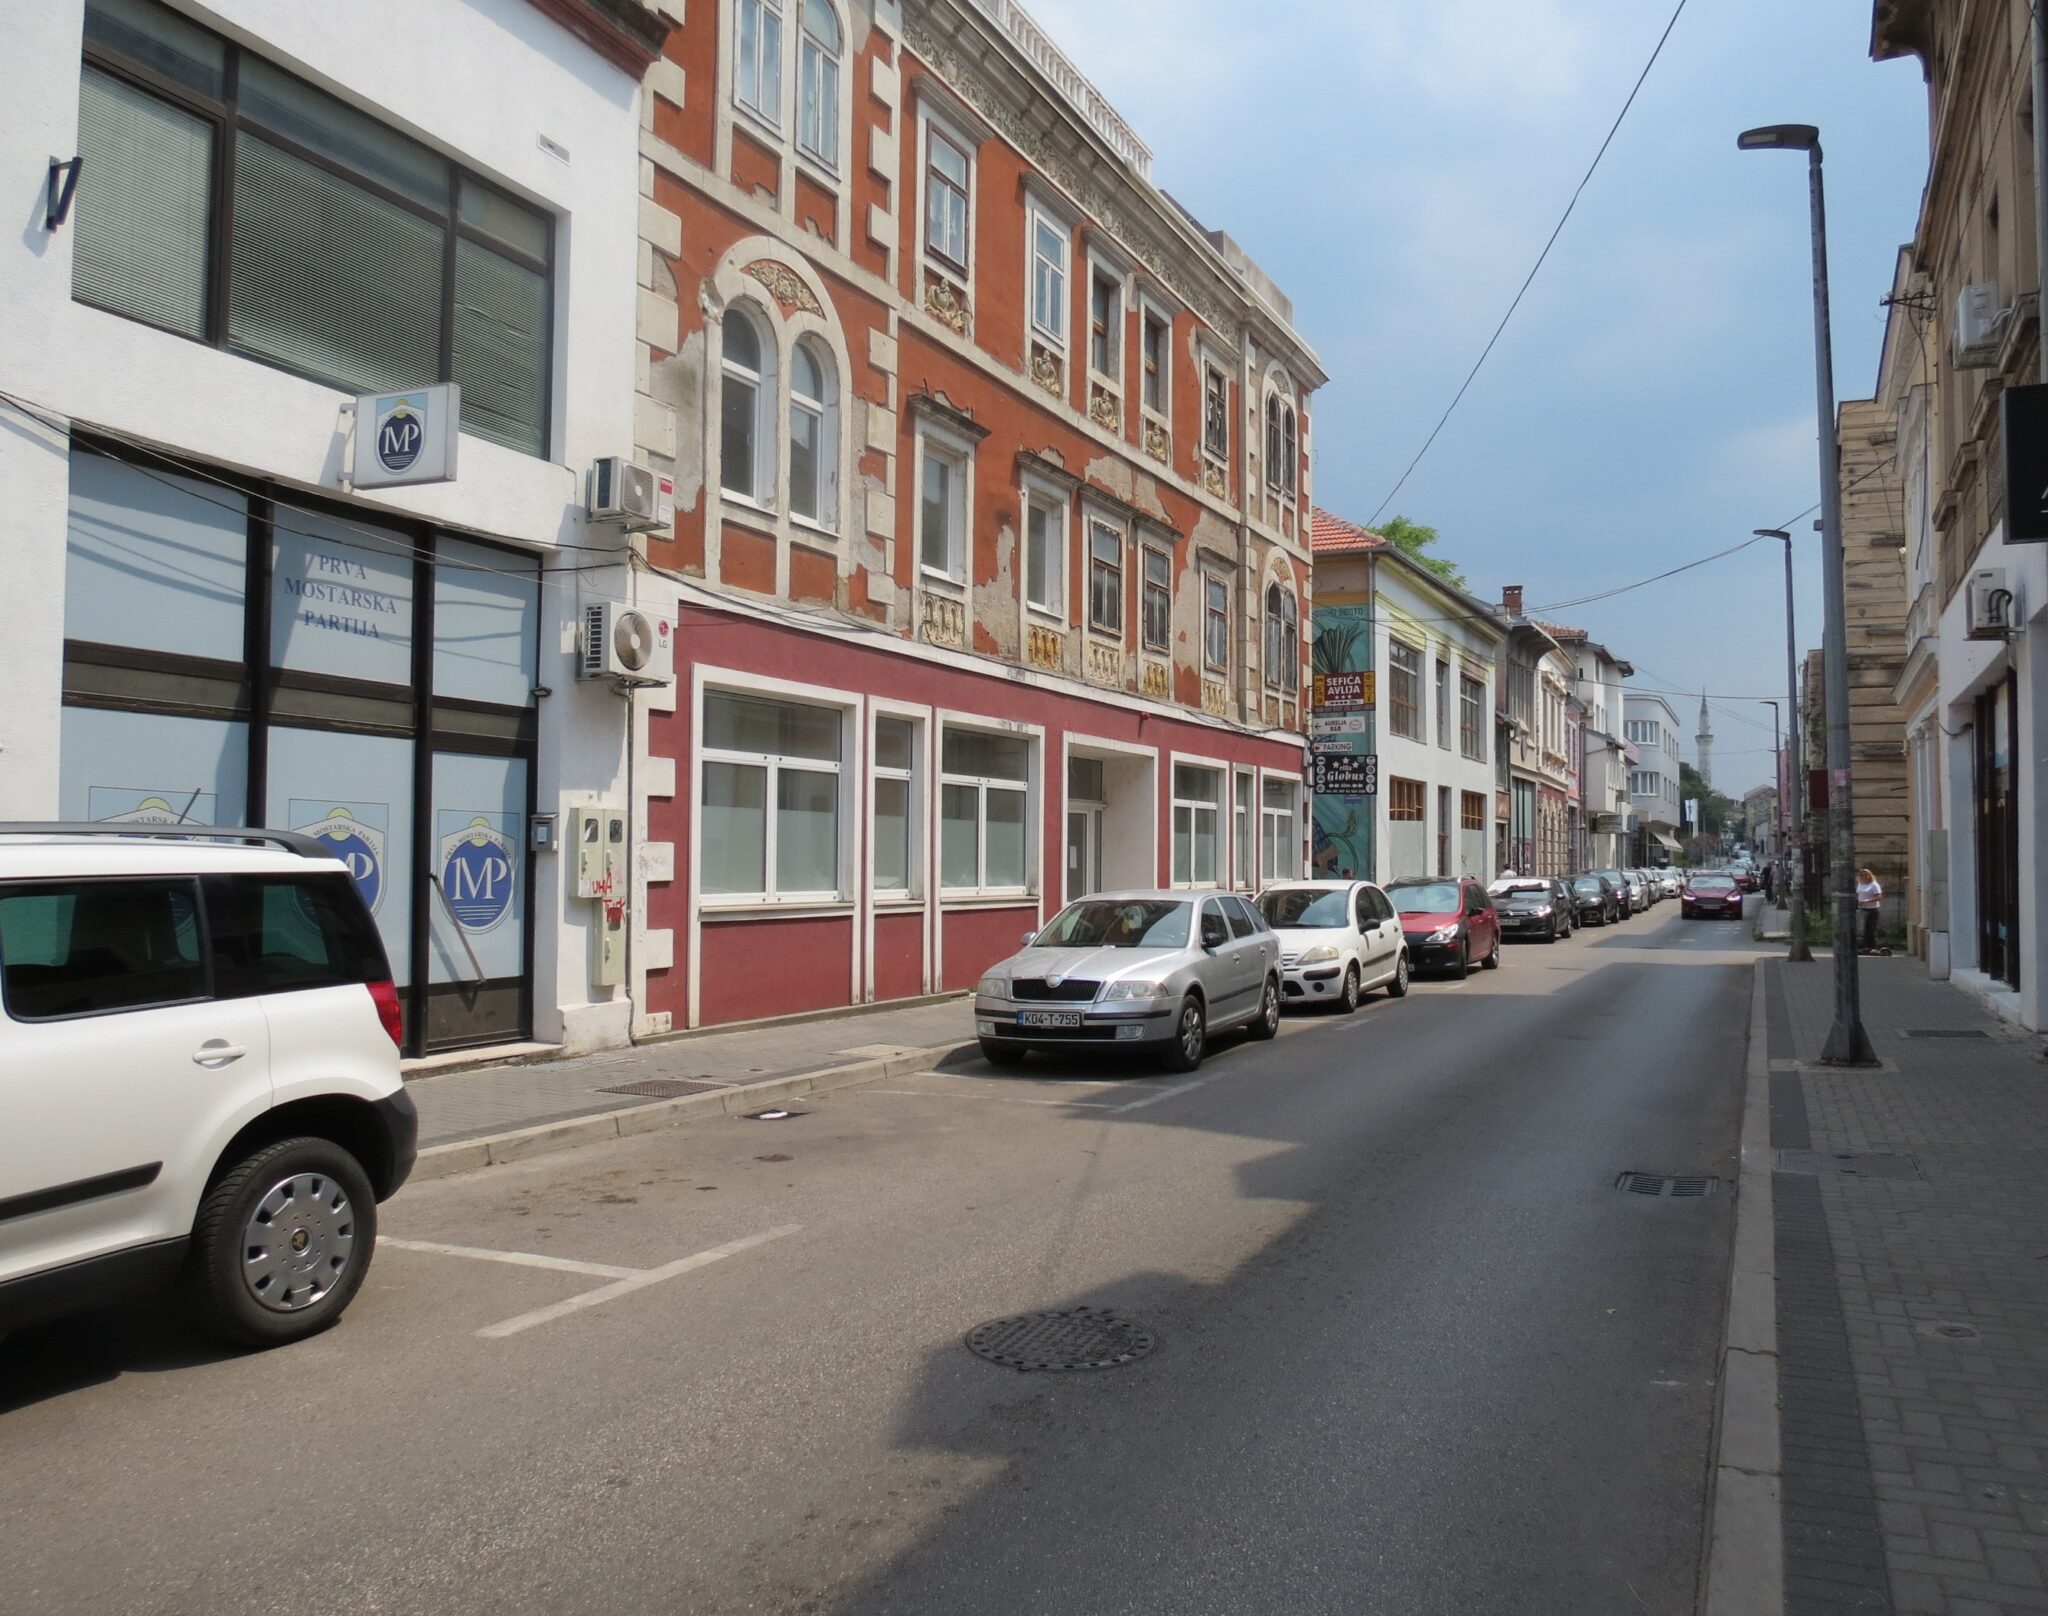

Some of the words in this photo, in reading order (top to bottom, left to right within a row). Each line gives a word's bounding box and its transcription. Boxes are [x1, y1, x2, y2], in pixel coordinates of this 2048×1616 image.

[319, 554, 367, 580] PRVA
[284, 577, 397, 614] MOSTARSKA
[304, 610, 380, 638] PARTIJA
[658, 639, 668, 648] LG
[1326, 674, 1361, 686] SEFIĆA
[1327, 685, 1361, 695] AVLIJA
[1323, 743, 1352, 751] PARKING
[1327, 771, 1364, 781] Globus
[1024, 1013, 1079, 1025] K04-T-755
